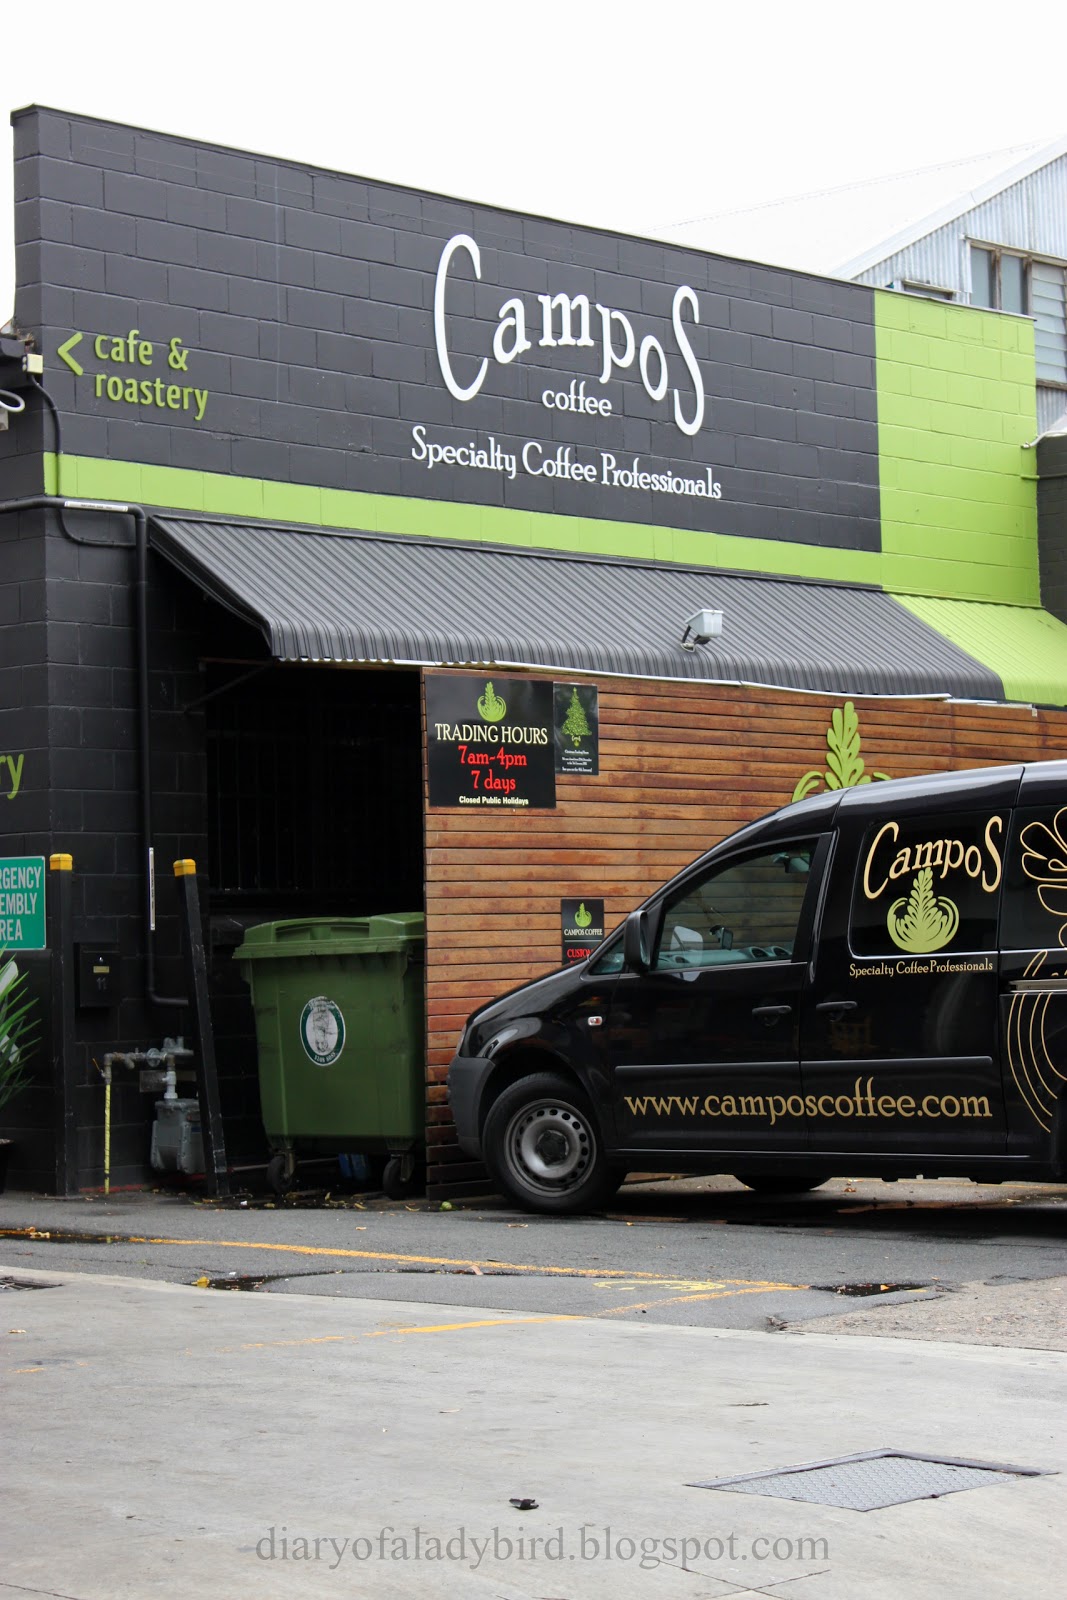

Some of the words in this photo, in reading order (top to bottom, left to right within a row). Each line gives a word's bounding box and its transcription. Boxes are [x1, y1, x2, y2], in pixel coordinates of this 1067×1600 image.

[95, 329, 153, 366] cafe
[168, 337, 189, 371] &
[95, 374, 208, 421] roastery
[542, 379, 613, 417] coffee
[411, 425, 516, 479] Specialty
[522, 441, 597, 482] Coffee
[600, 453, 722, 499] Professionals
[435, 723, 498, 743] TRADING
[501, 726, 548, 744] HOURS
[458, 745, 527, 769] 7am-4pm
[471, 770, 481, 789] 7
[484, 769, 516, 794] days
[459, 796, 481, 804] Closed
[482, 796, 501, 804] Public
[503, 796, 529, 806] Holidays
[563, 928, 584, 936] CAMPOS
[585, 928, 603, 936] COFFEE
[850, 962, 894, 978] Specialty
[896, 961, 929, 975] Coffee
[930, 958, 993, 973] Professionals
[624, 1076, 993, 1126] www.camposcoffee.com
